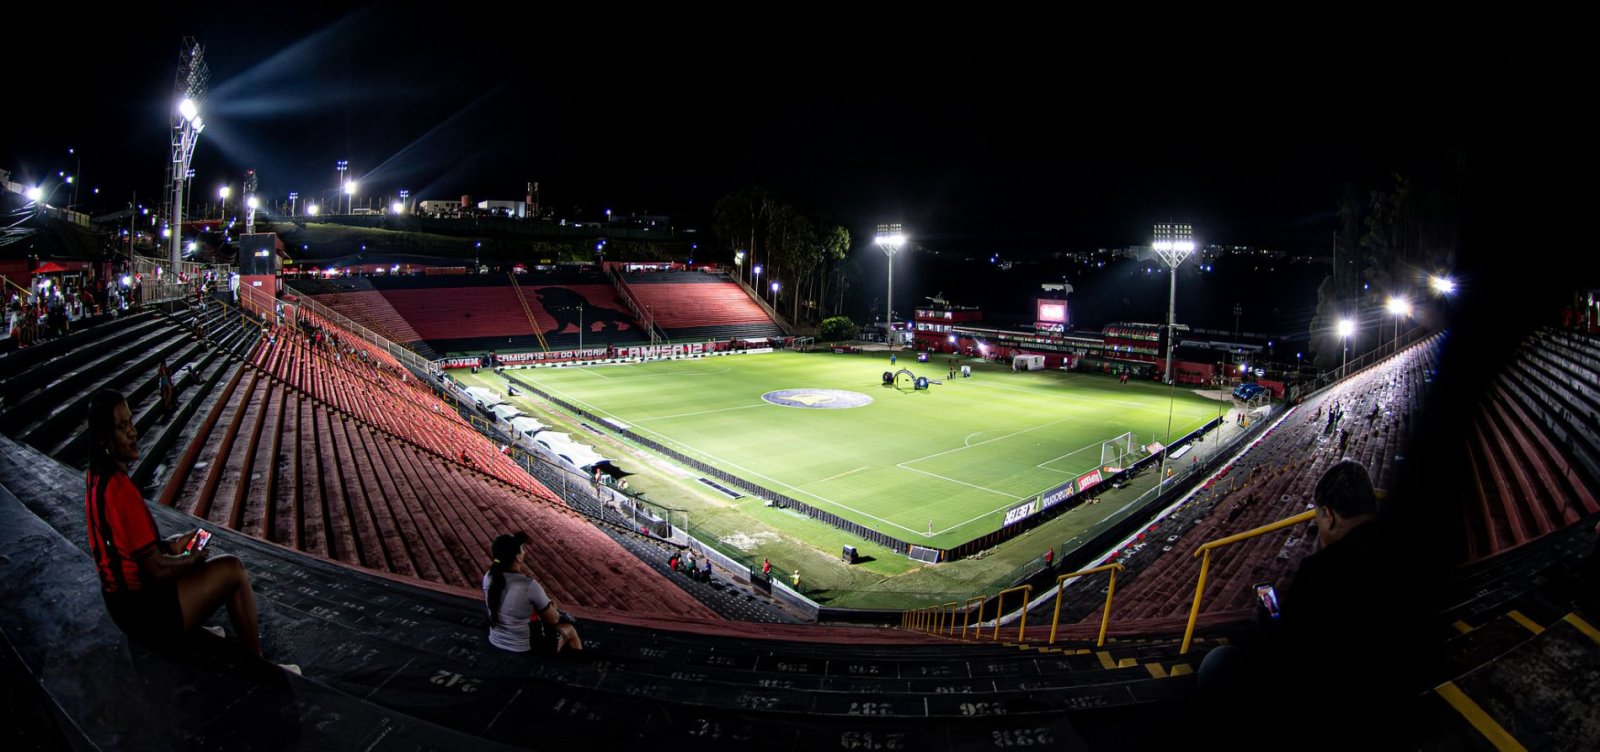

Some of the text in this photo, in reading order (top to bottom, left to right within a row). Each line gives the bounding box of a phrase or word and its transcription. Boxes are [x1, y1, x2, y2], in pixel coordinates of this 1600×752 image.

[618, 343, 703, 358] CAMISA 12
[447, 358, 479, 366] JOVEM
[496, 353, 535, 362] CAMISA
